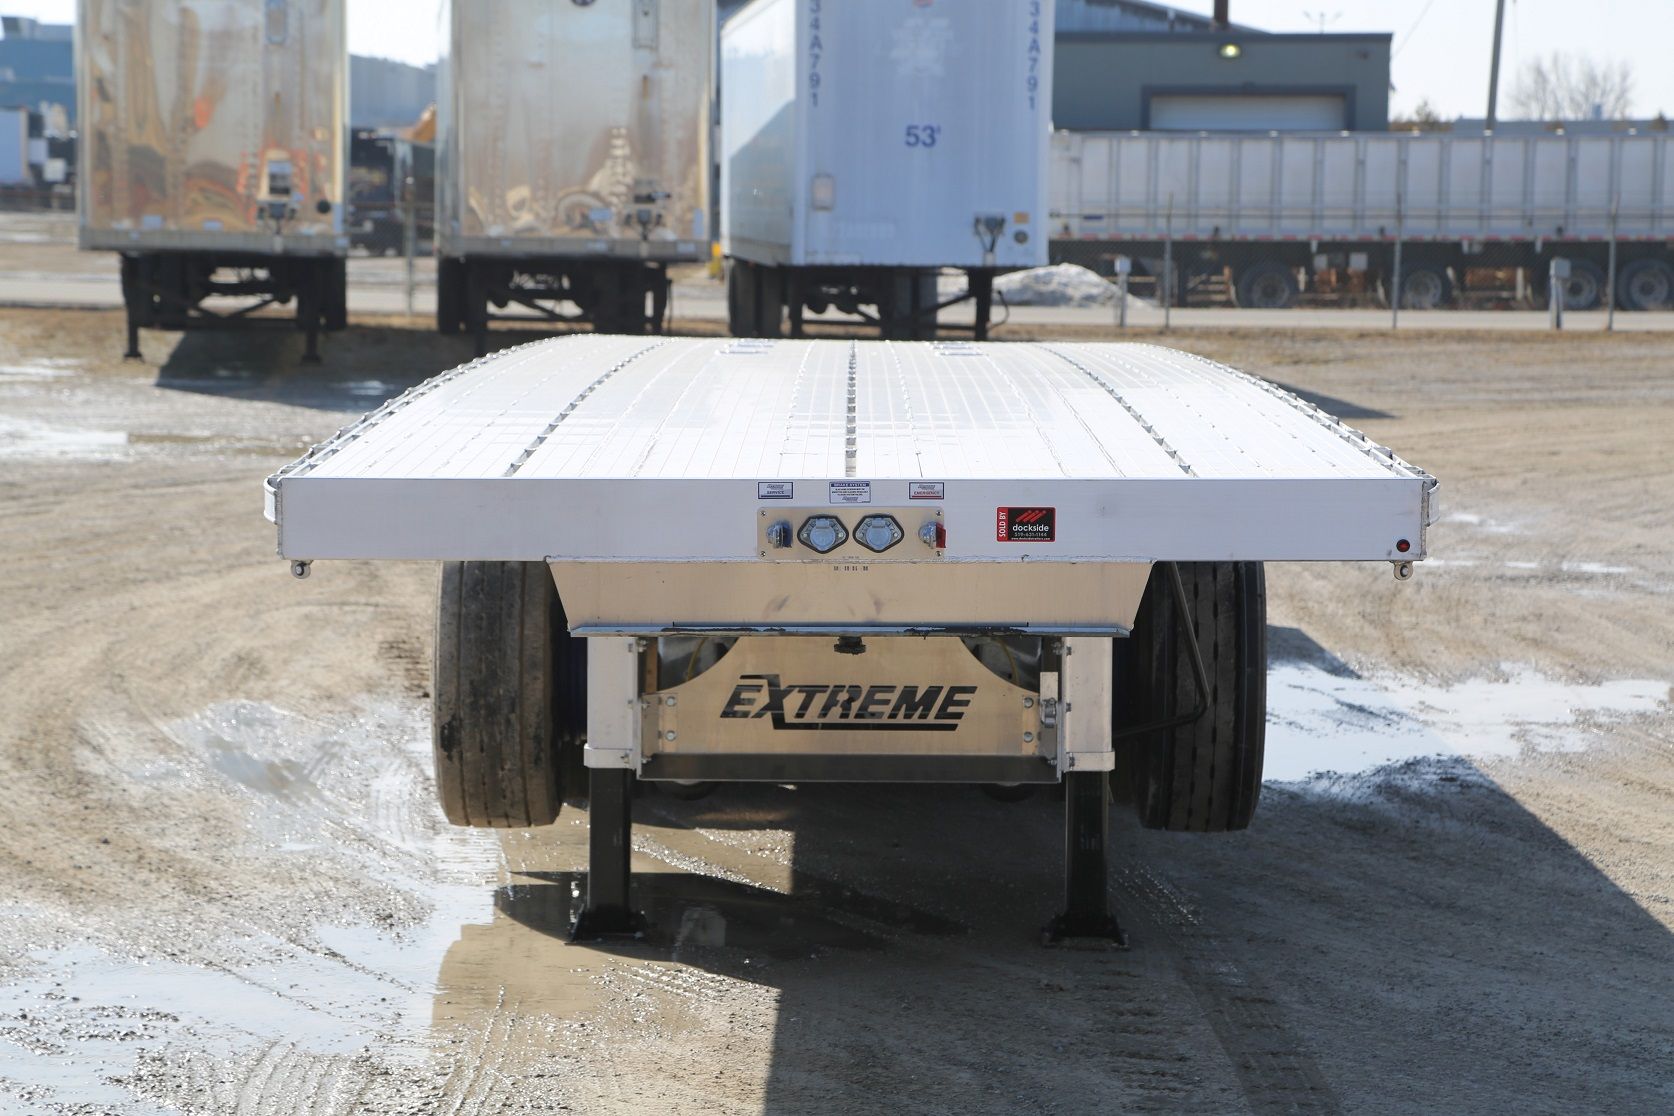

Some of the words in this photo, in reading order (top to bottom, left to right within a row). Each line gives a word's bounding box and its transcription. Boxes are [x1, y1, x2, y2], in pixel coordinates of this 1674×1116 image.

[998, 511, 1006, 520] BY
[998, 521, 1006, 537] SOLD
[1012, 524, 1049, 532] dockside
[720, 674, 978, 731] EXTREME
